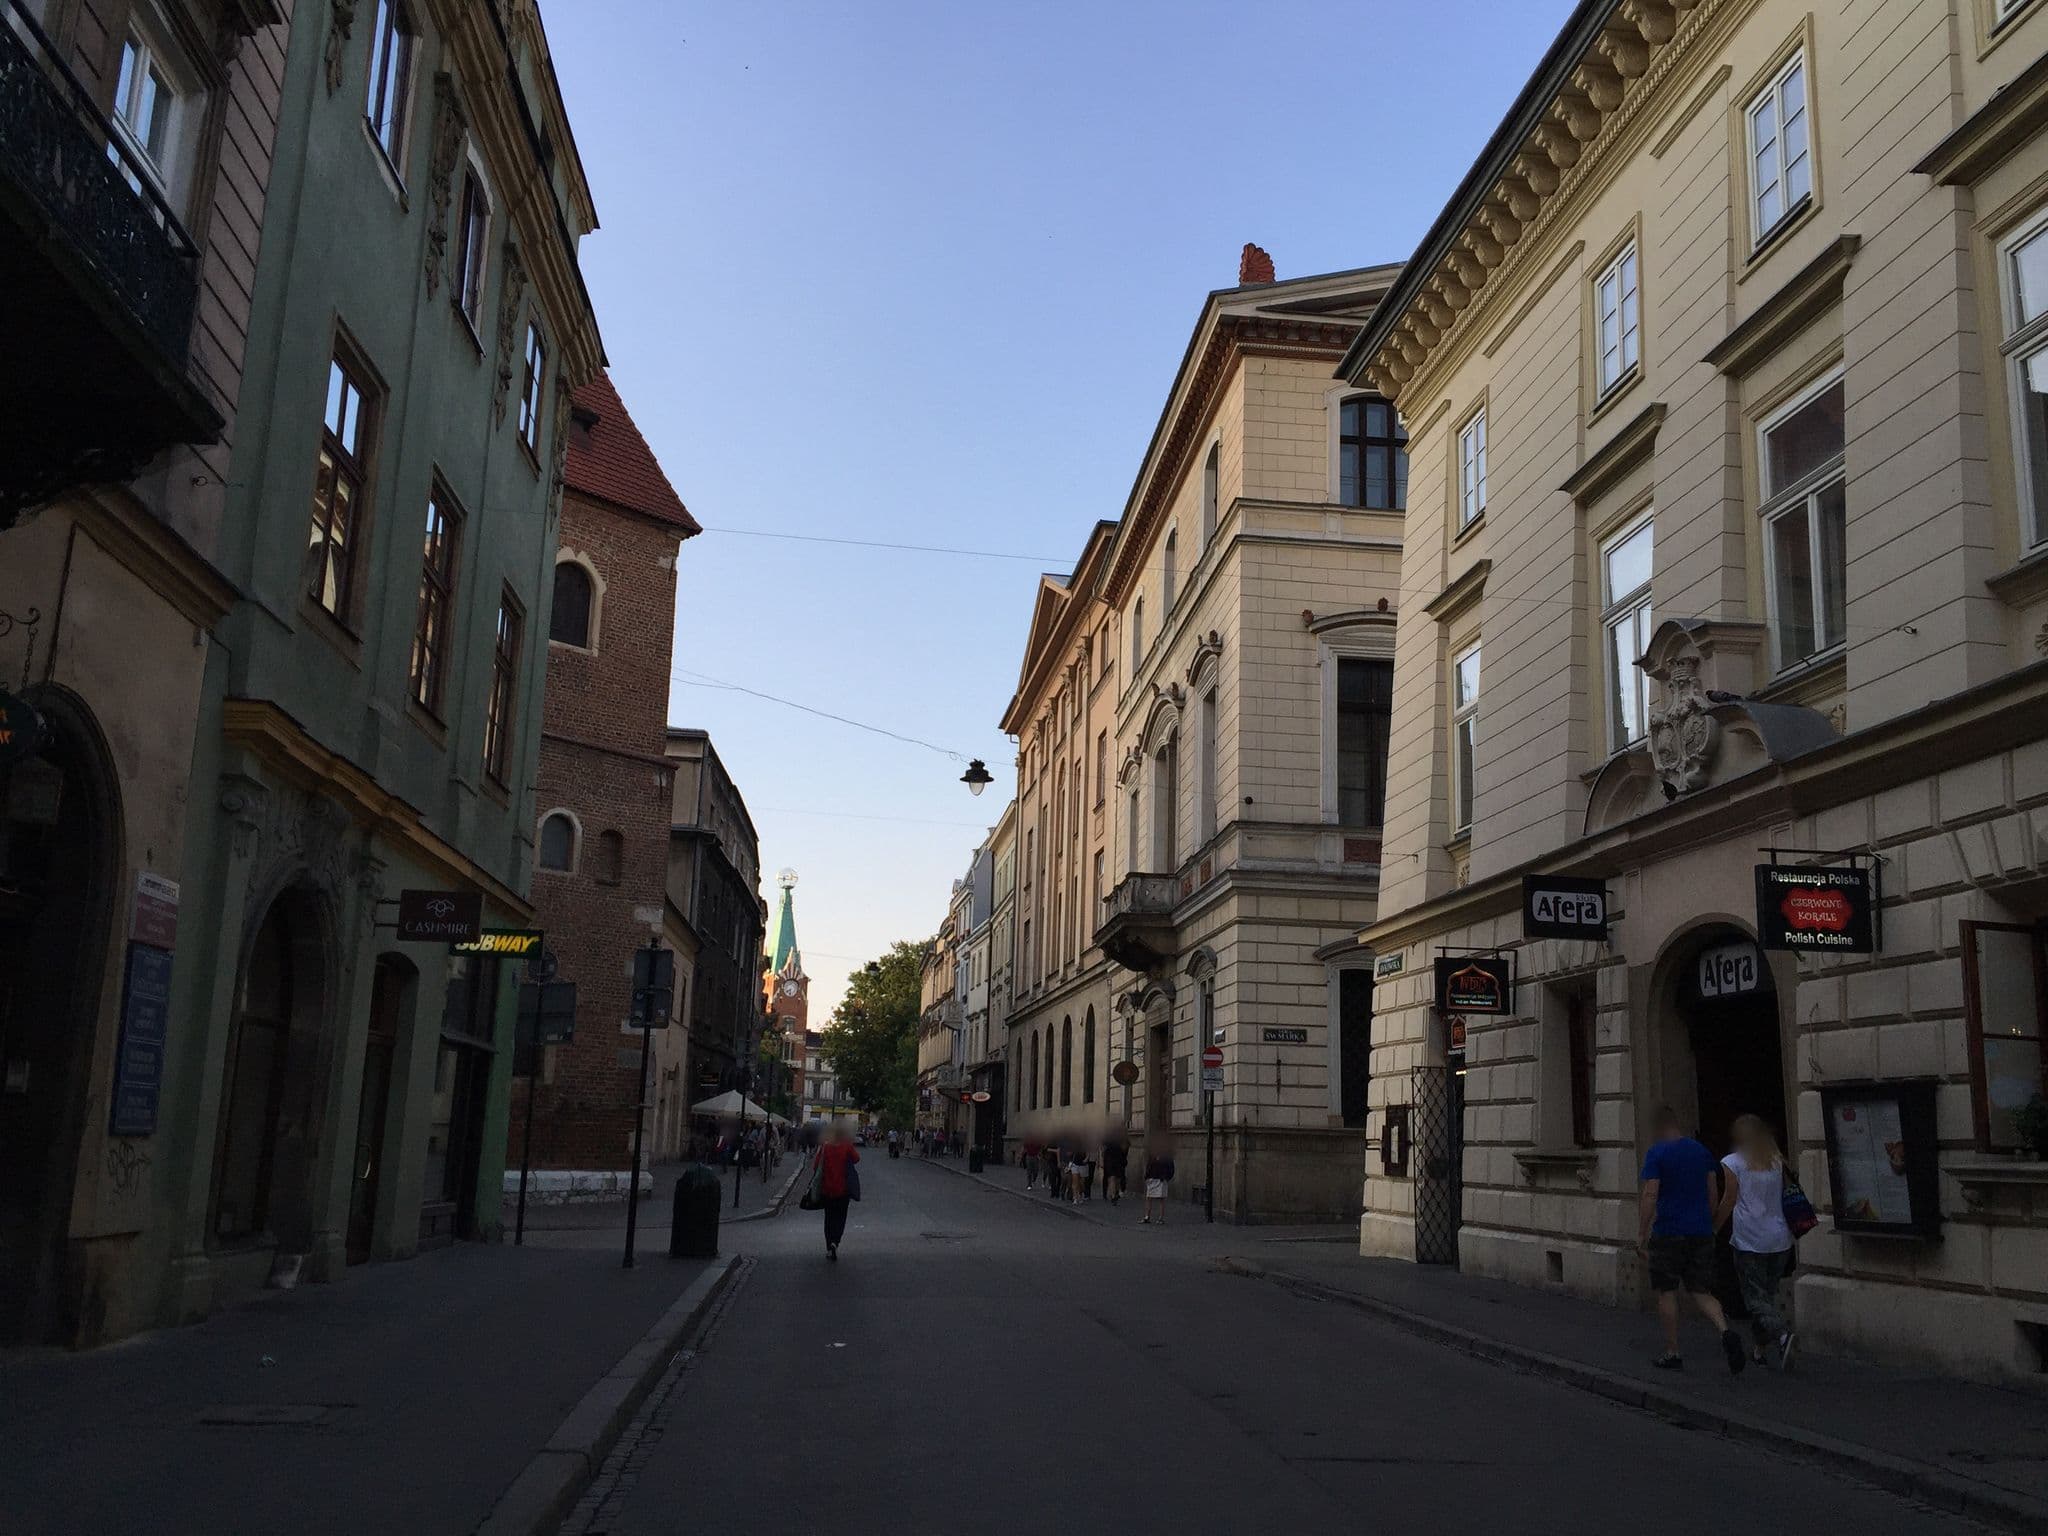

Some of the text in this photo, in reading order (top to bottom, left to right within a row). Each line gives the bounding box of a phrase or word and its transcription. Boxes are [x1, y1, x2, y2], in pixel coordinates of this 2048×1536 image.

[1770, 871, 1861, 886] Restauracja Polska
[1537, 896, 1598, 924] Afera
[1790, 898, 1842, 909] CZERWONE
[1797, 911, 1838, 922] KORALE
[1785, 931, 1853, 945] Polish Cuisine
[1704, 953, 1753, 993] Afera
